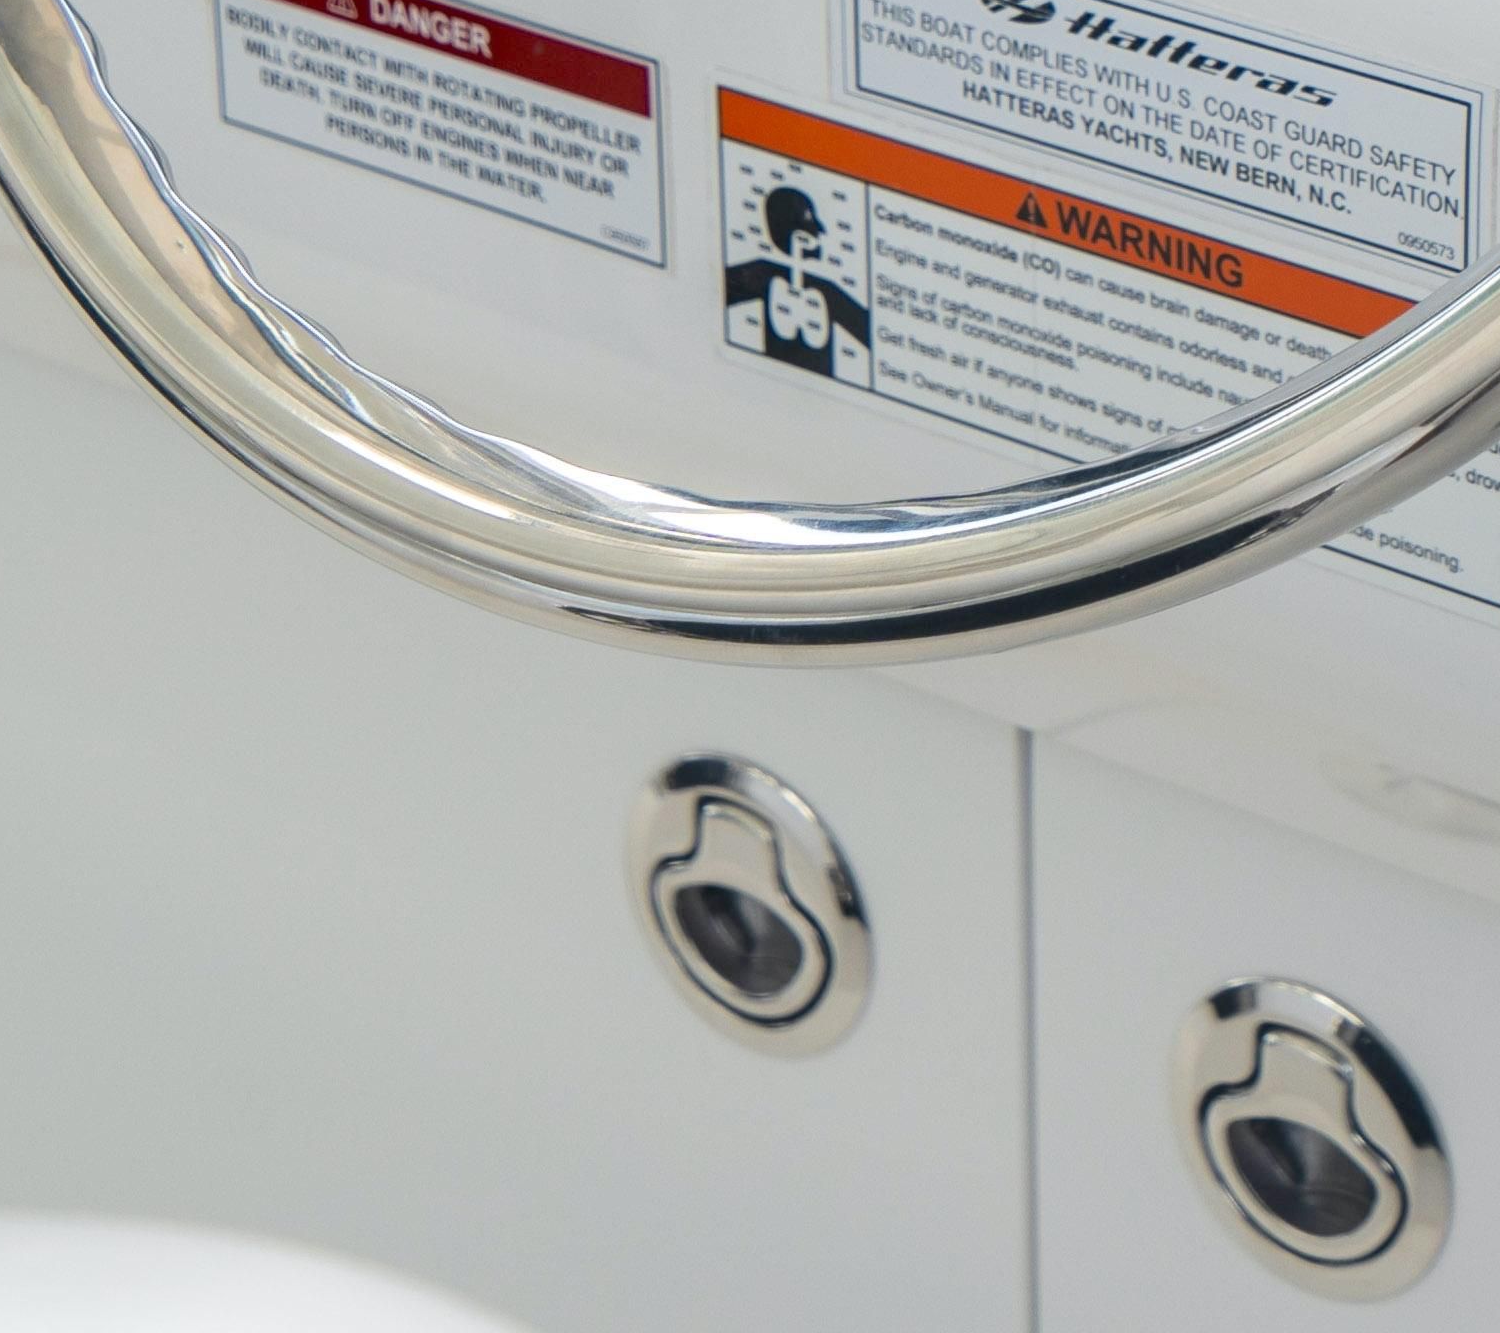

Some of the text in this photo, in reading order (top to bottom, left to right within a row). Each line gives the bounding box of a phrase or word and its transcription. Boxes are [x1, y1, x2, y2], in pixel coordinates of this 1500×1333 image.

[226, 3, 643, 155] BODILY CONTACT WITH ROTATING PROPELLER
[242, 36, 631, 178] WILL CAUSE SEVERE PERSONAL INJURY OR
[860, 22, 985, 76] STANDARDS
[989, 60, 1011, 83] IN
[1015, 67, 1096, 109] EFFECT
[1102, 93, 1136, 121] ON
[1141, 104, 1184, 136] THE
[1189, 119, 1247, 155] DATE
[1252, 138, 1283, 163] OF
[919, 11, 976, 46] BOAT
[980, 30, 1089, 80] COMPLIES
[1093, 61, 1150, 98] WITH
[1202, 95, 1278, 134] COAST
[1283, 119, 1364, 160] GUARD
[1368, 144, 1457, 187] SAFETY
[1063, 10, 1338, 108] Hatteras
[325, 112, 412, 159] PERSONS
[413, 139, 434, 165] IN
[438, 148, 471, 177] THE
[328, 86, 377, 124] TURN
[380, 105, 416, 134] OFF
[420, 117, 499, 164] ENGINES
[503, 141, 560, 180] WHEN
[562, 163, 617, 200] NEAR
[961, 80, 1353, 216] HATTERAS YACHTS, NEW BERN, N.C.
[874, 203, 934, 235] Carbon
[937, 226, 1020, 265] monoxide
[1022, 250, 1063, 280] (CO)
[1065, 266, 1095, 288] can
[1097, 275, 1146, 305] cause
[1149, 290, 1191, 319] brain
[1193, 307, 1261, 343] damage
[1264, 331, 1283, 348] or
[1056, 199, 1244, 289] WARNING
[875, 238, 1285, 385] Engine and generator exhaust contains odorless and
[876, 291, 905, 313] and
[909, 303, 939, 326] lack
[876, 273, 918, 304] Signs
[940, 295, 994, 325] carbon
[997, 314, 1073, 352] monoxide
[1076, 340, 1152, 382] poisoning
[1155, 362, 1214, 399] include
[876, 325, 906, 347] Get
[908, 336, 947, 361] fresh
[950, 352, 970, 369] air
[986, 364, 1044, 395] anyone
[1047, 383, 1098, 414] shows
[1101, 402, 1143, 428] signs
[878, 359, 1060, 434] See Owner's Manual for
